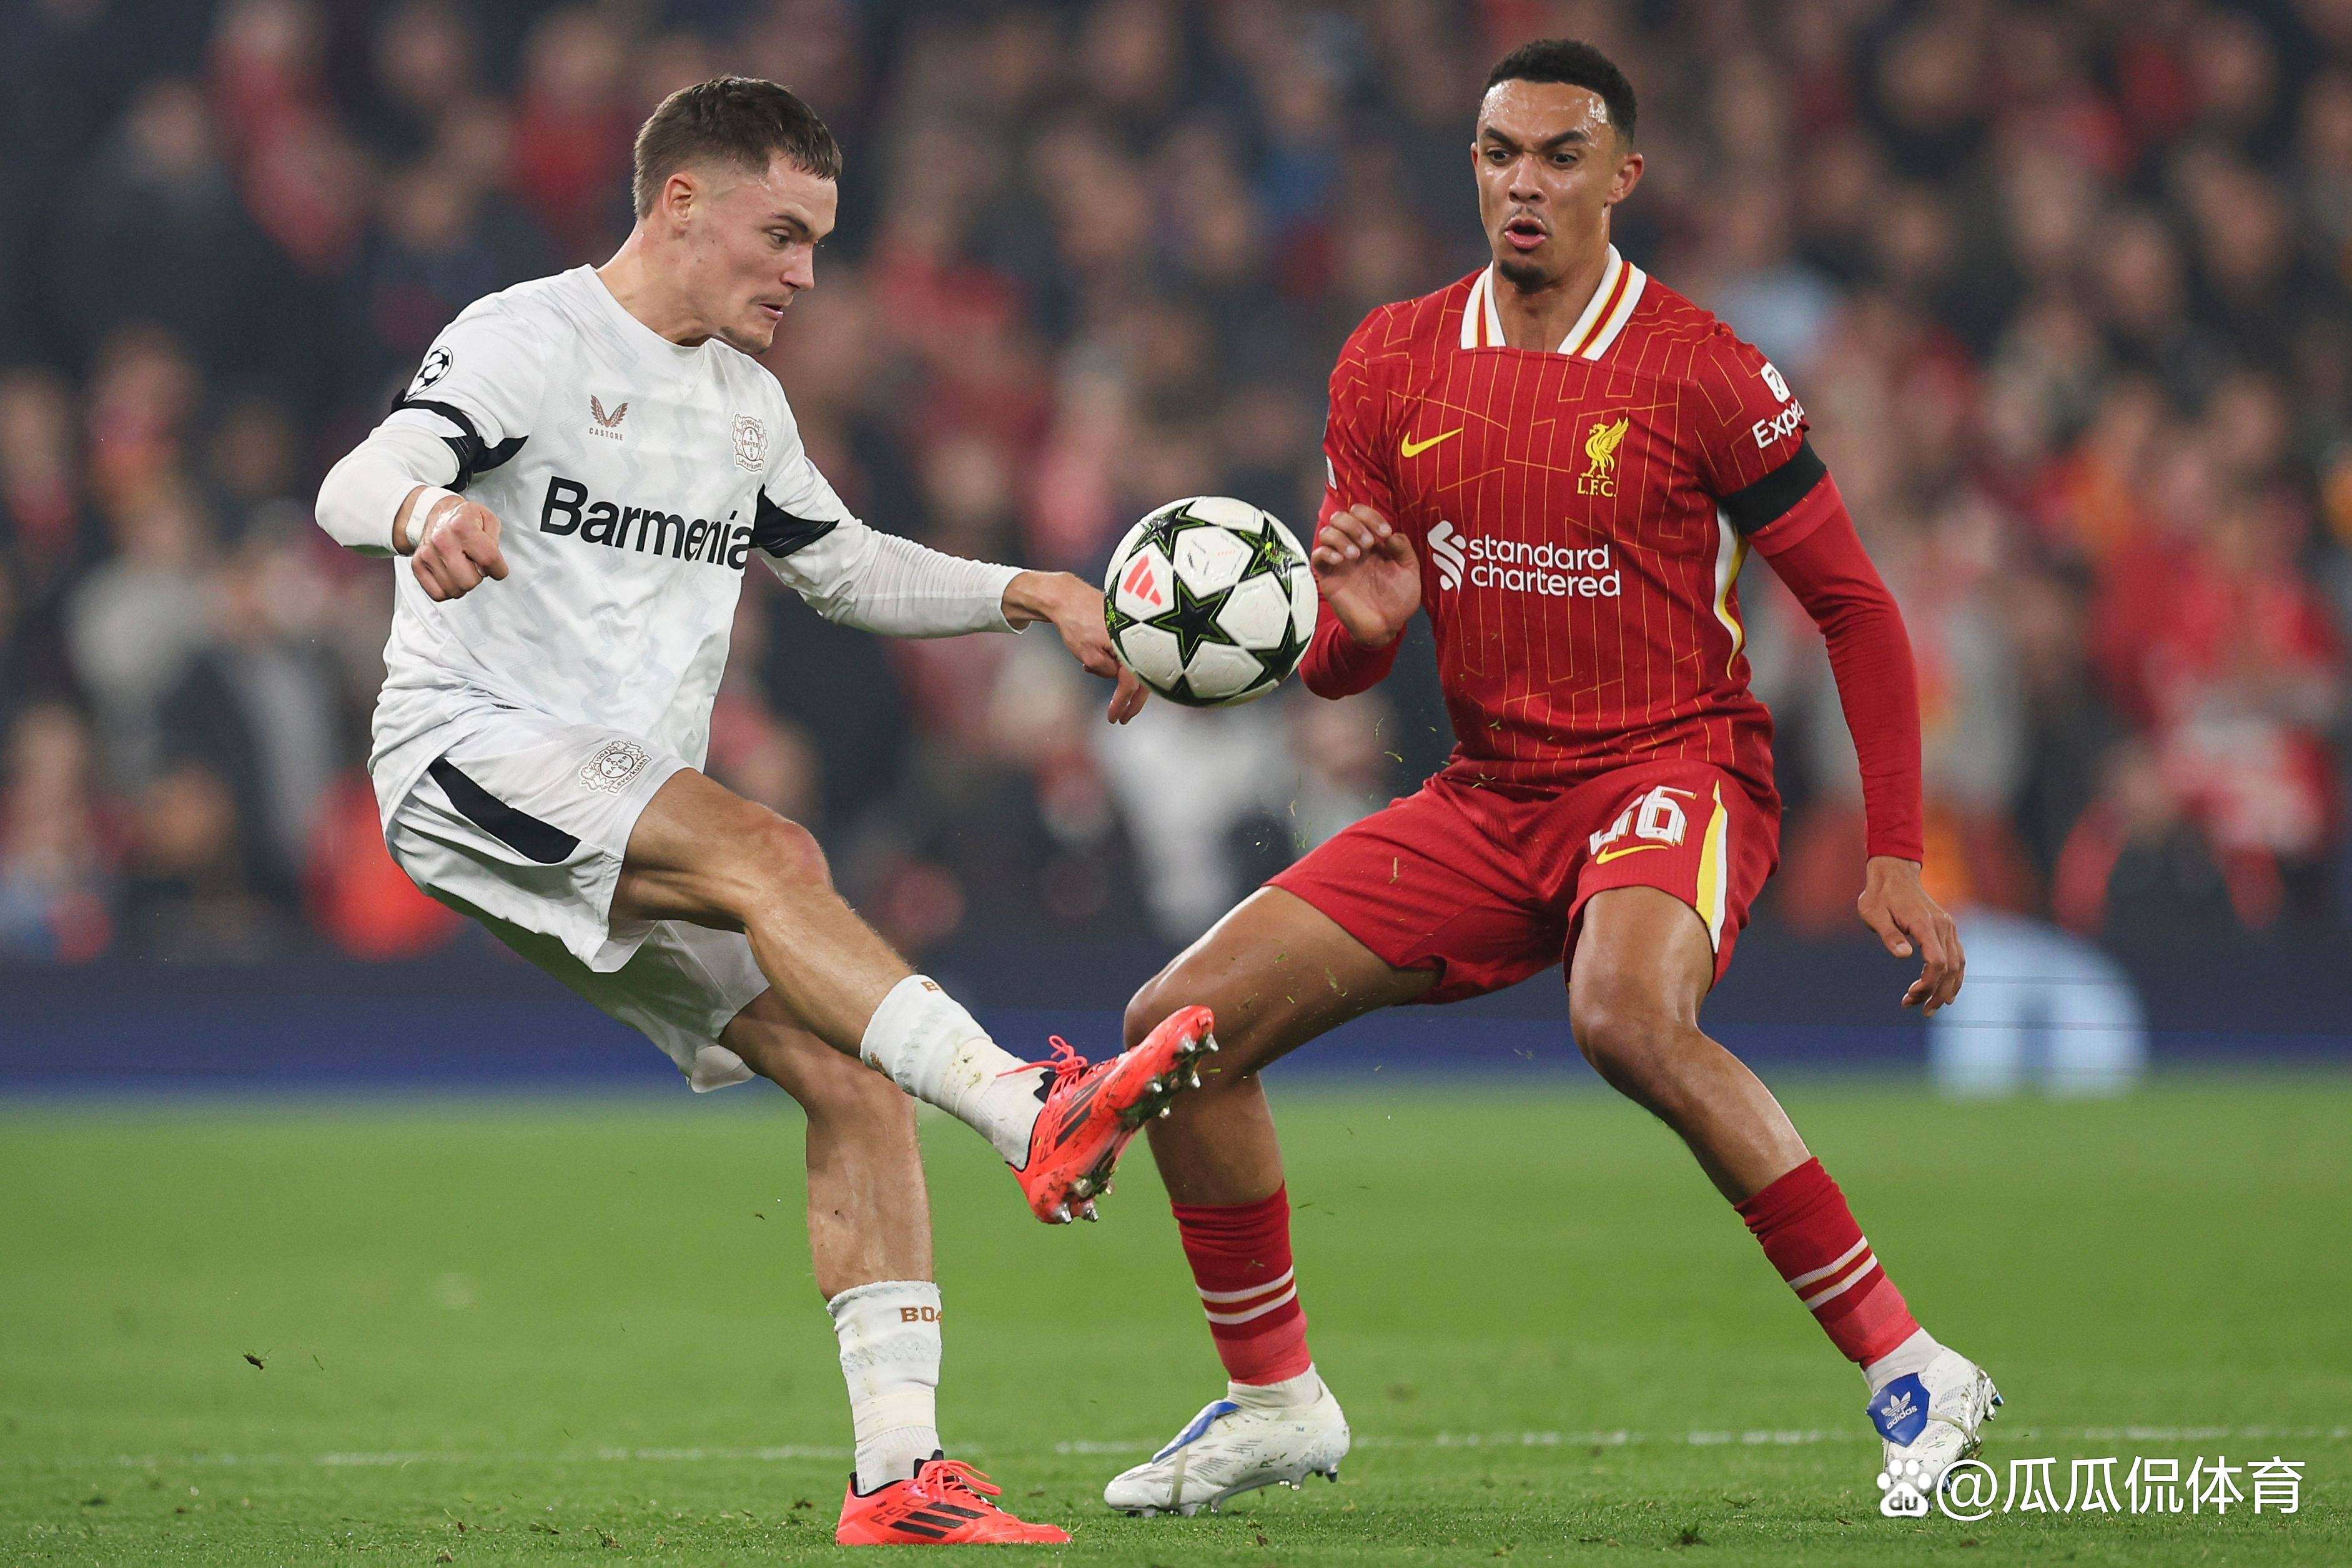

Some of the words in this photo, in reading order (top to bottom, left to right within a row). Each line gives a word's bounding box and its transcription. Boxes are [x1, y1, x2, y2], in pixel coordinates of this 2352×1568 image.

[589, 427, 623, 441] CASTORE
[540, 476, 753, 570] Barmenia
[1469, 533, 1610, 571] standard
[1470, 561, 1621, 598] chartered
[612, 758, 648, 789] Leverkusen
[1887, 1404, 1917, 1430] adidas
